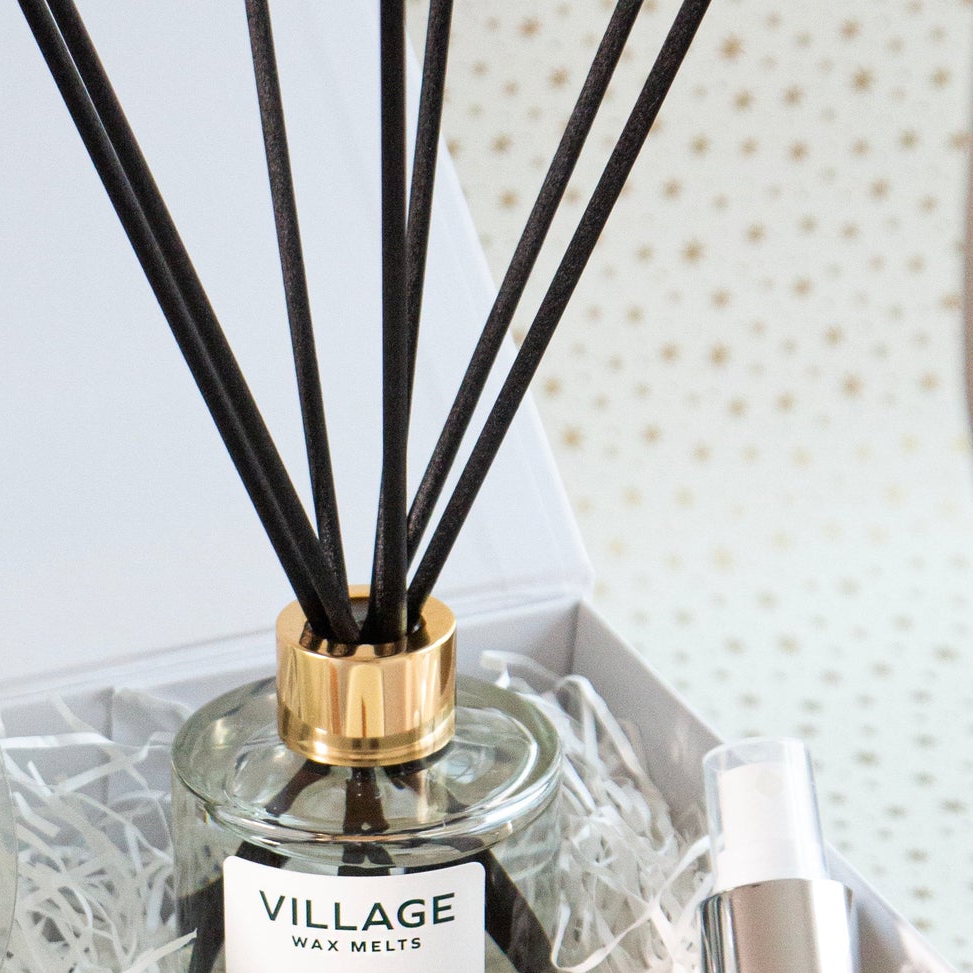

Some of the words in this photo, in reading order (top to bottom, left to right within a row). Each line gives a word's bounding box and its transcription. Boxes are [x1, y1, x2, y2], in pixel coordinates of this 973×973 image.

[259, 890, 456, 931] VILLAGE
[291, 935, 339, 952] WAX
[350, 937, 422, 953] MELTS
